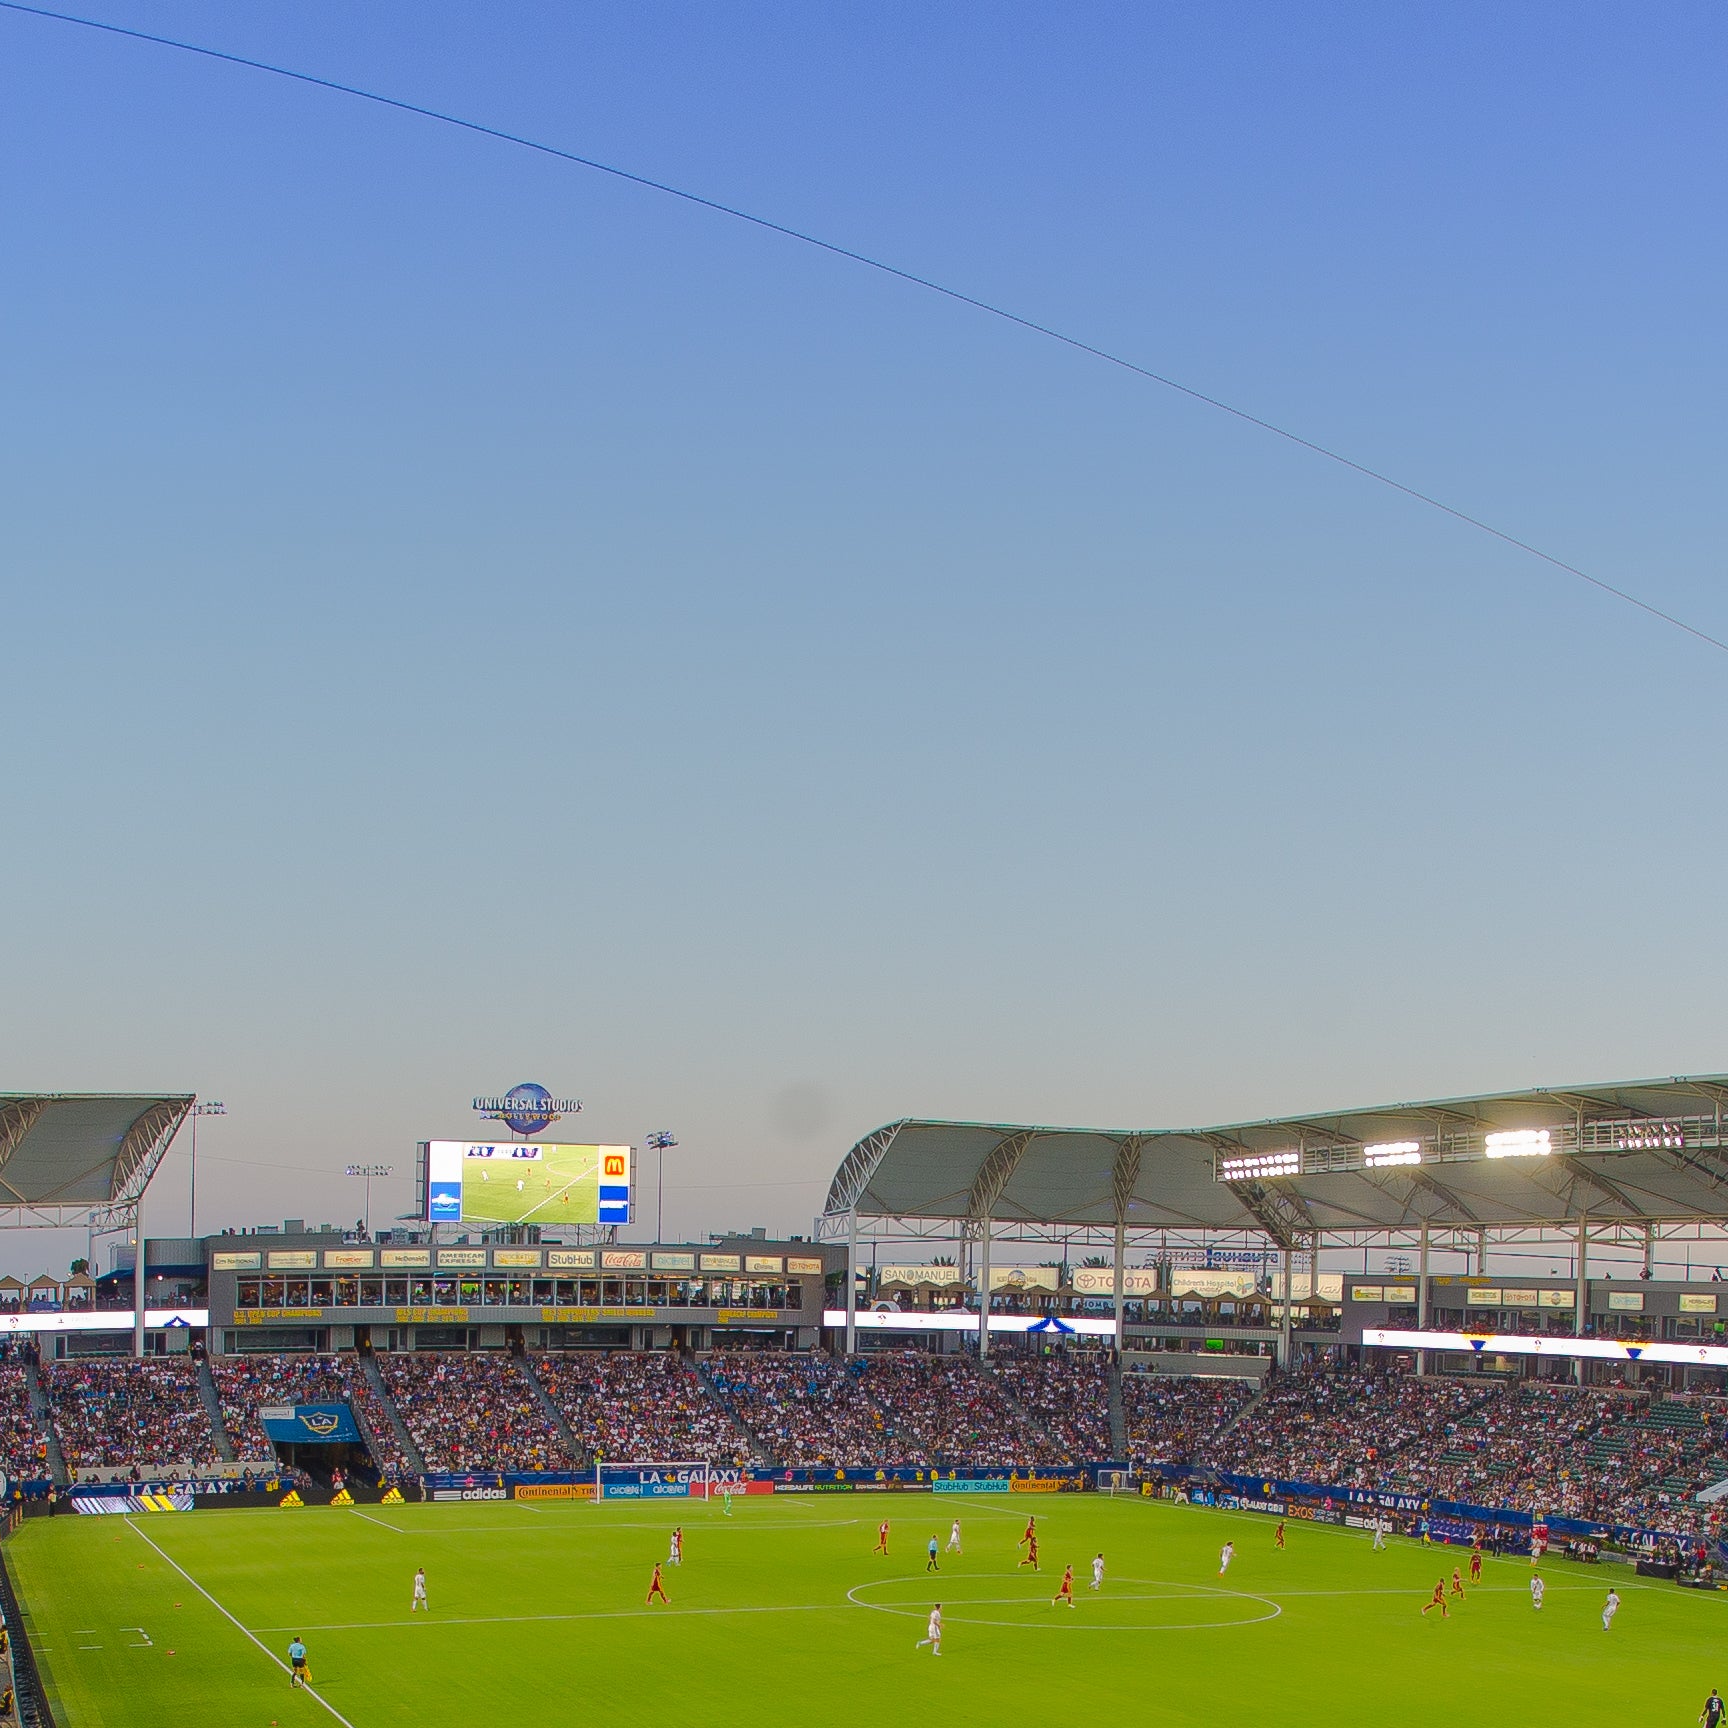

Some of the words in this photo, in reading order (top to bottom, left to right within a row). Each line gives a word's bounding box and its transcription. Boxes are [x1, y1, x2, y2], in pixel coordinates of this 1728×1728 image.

[475, 1098, 538, 1111] UNIVERSAL
[540, 1099, 584, 1113] STUDIOS
[551, 1253, 593, 1265] StubHub
[885, 1270, 906, 1280] SAN
[915, 1270, 958, 1281] MANUEL
[1098, 1275, 1151, 1288] TOOTA
[640, 1472, 660, 1484] LA
[677, 1470, 739, 1483] GALAXY
[934, 1480, 968, 1491] StubHub
[463, 1488, 506, 1500] adidas
[1288, 1506, 1313, 1519] EXOS
